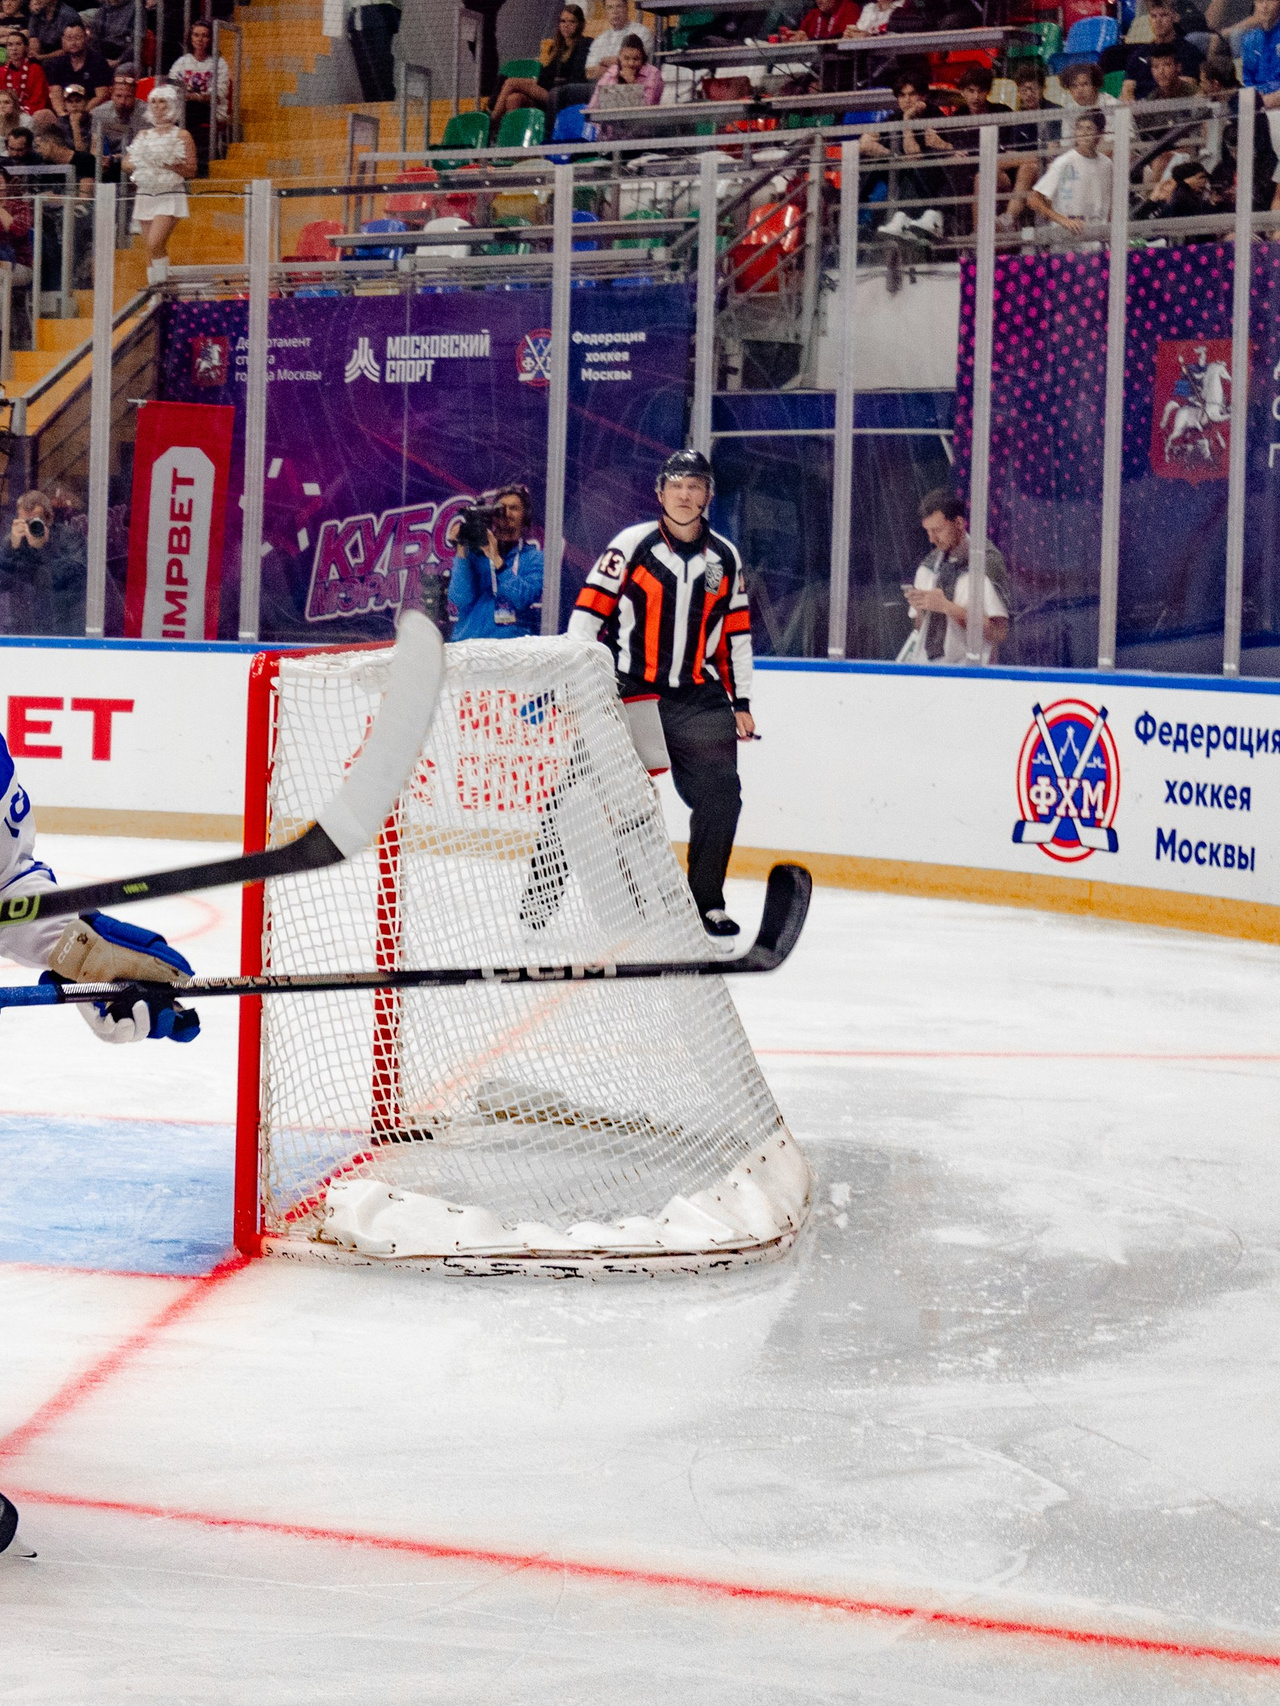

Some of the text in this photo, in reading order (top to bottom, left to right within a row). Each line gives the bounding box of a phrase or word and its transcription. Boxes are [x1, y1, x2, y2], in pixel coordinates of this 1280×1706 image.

[235, 336, 312, 351] Дертамент
[386, 329, 490, 359] МОСКОВСКИЙ
[571, 331, 646, 346] Федерация
[585, 351, 630, 363] хоккея
[277, 369, 322, 381] Москвы
[385, 360, 435, 383] СПОРТ
[581, 368, 632, 381] Москвы
[1134, 710, 1280, 759] Федерация
[1029, 775, 1106, 820] ФХМ
[1164, 779, 1252, 812] хоккея
[1155, 827, 1256, 872] Москвы
